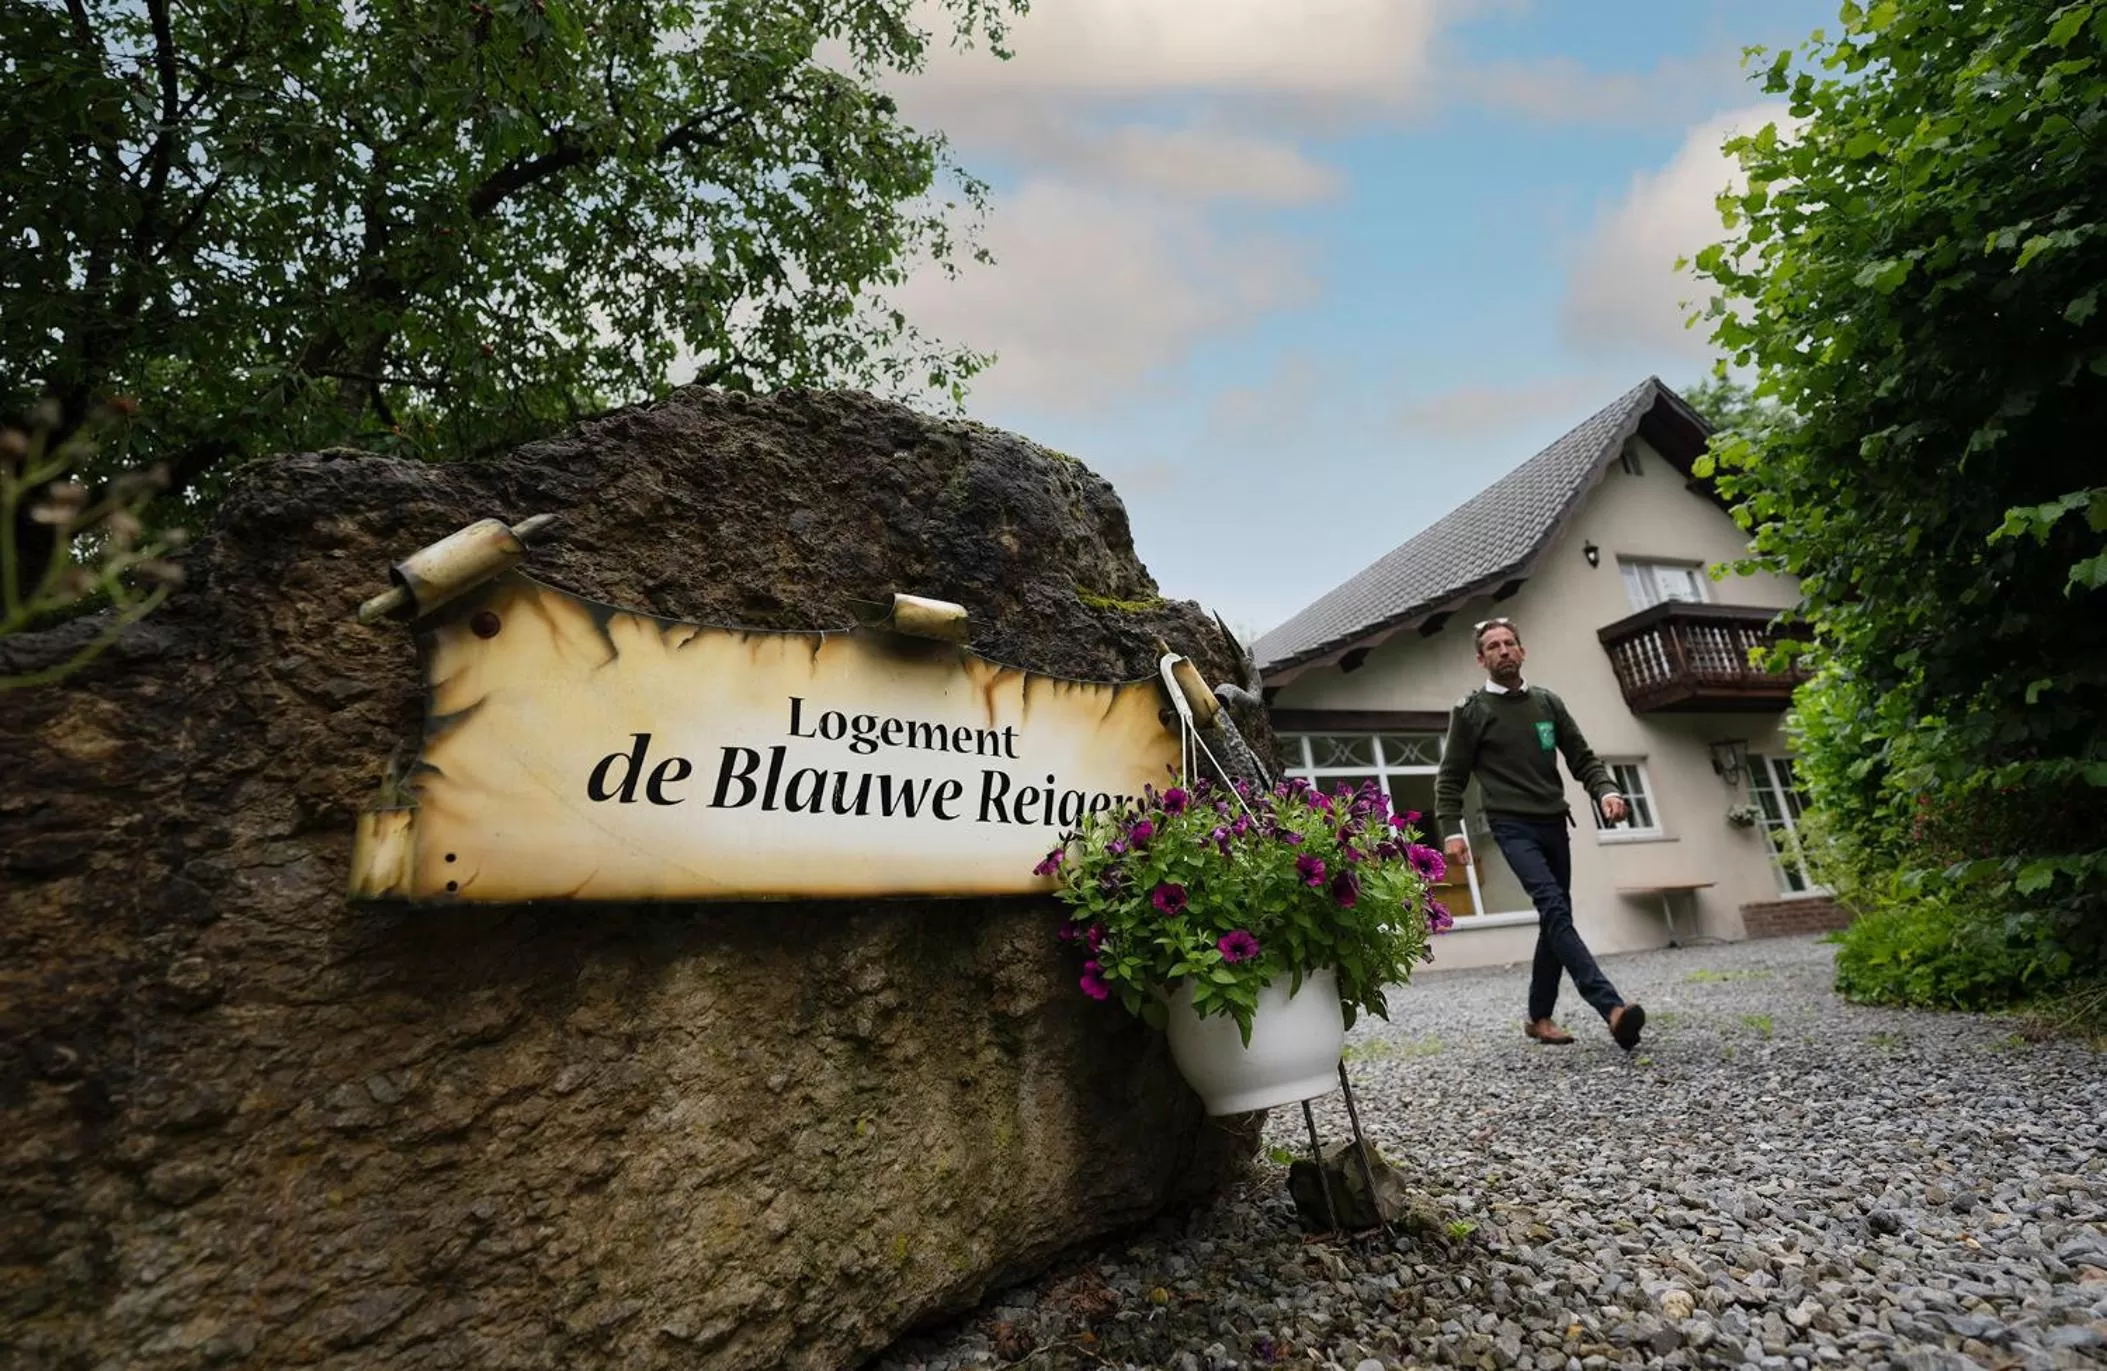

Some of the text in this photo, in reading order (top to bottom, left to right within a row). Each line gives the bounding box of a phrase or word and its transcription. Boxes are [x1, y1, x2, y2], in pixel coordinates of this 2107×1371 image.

[788, 696, 1020, 759] Logement
[587, 732, 692, 806] de
[707, 745, 963, 821] Blauwe
